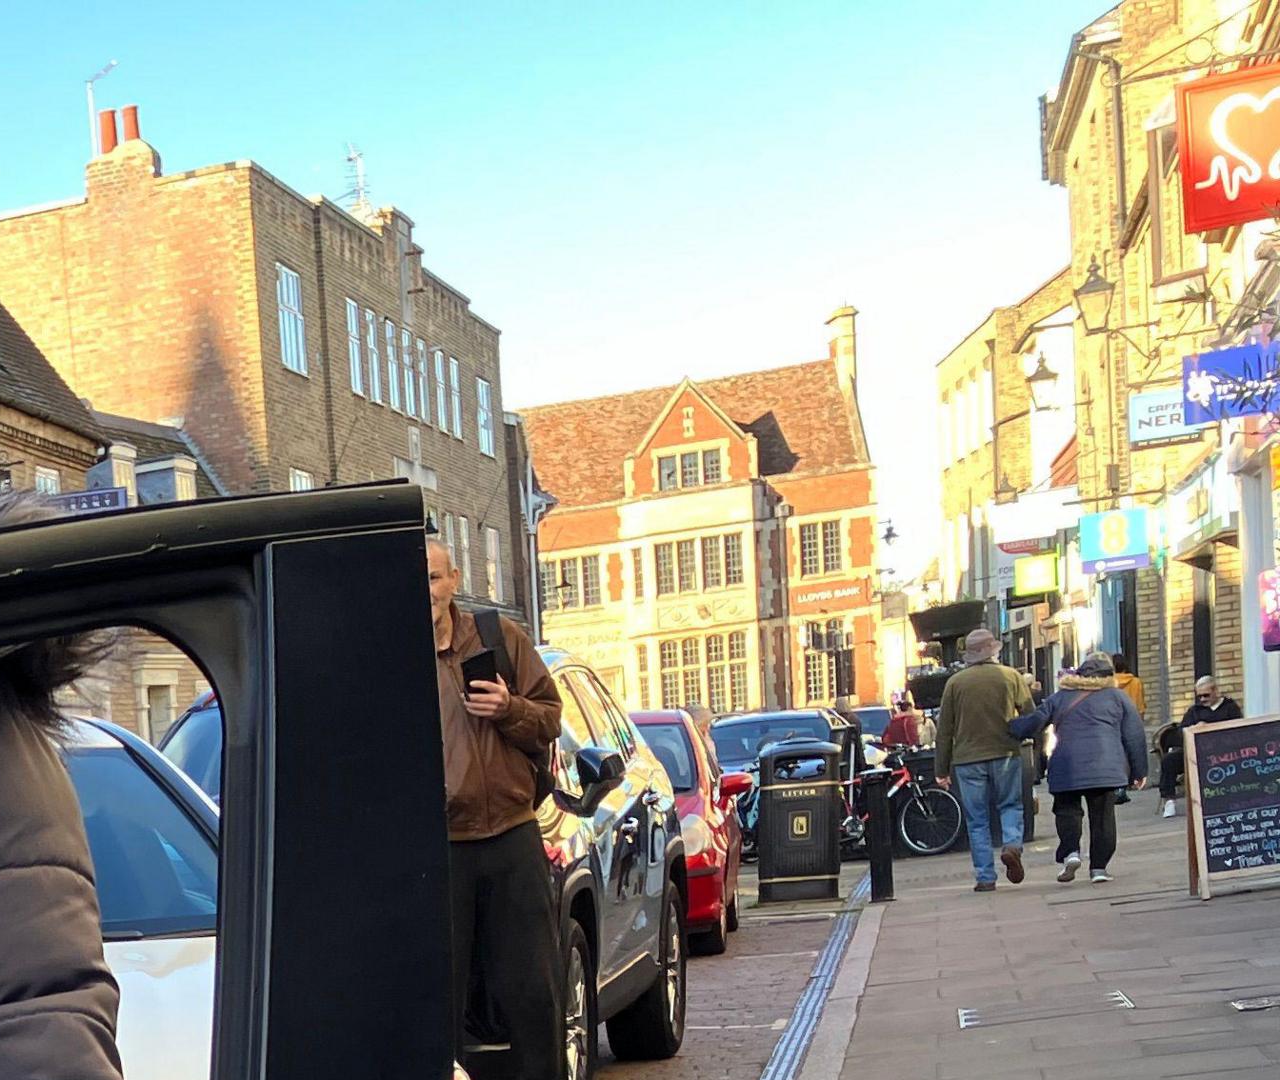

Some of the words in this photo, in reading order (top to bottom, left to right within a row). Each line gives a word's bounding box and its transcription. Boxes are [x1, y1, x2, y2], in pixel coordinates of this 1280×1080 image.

[1138, 412, 1182, 429] NER
[797, 590, 833, 604] LLOYDS
[834, 586, 861, 599] BANK
